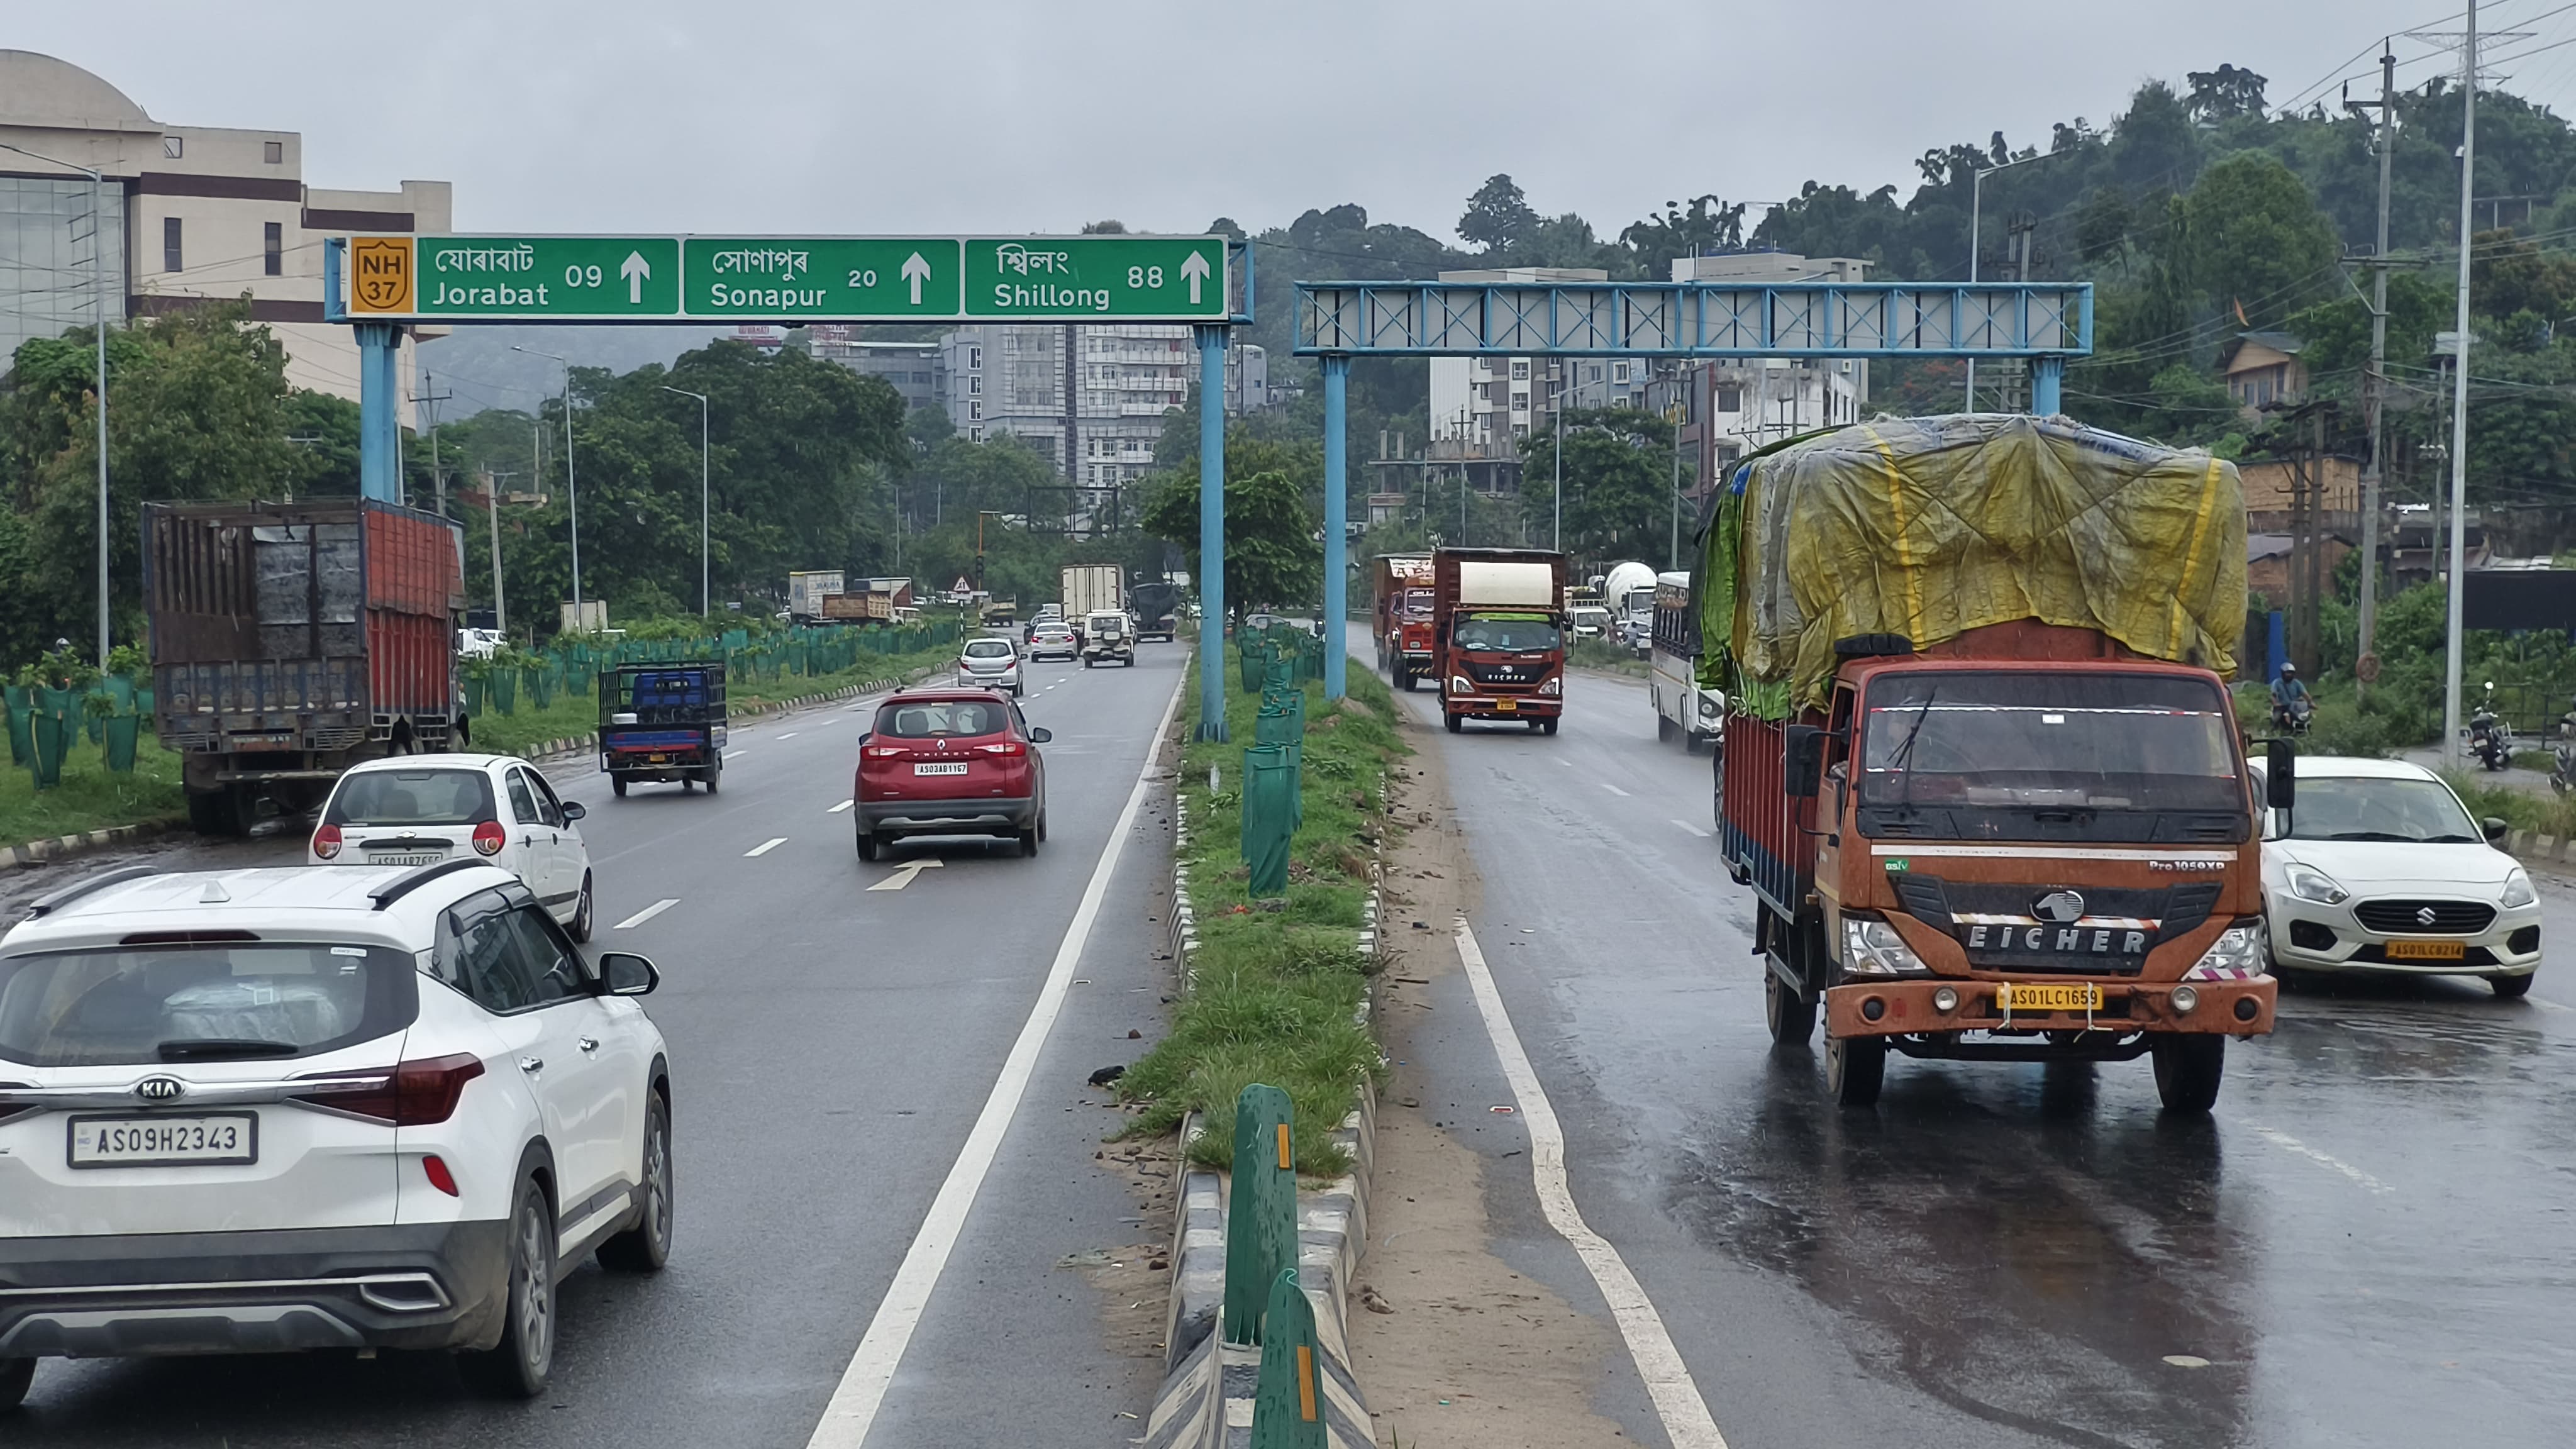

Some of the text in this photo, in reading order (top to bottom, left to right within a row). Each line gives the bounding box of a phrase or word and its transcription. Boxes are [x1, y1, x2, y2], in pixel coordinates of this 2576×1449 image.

[362, 255, 401, 275] NH
[435, 242, 534, 272] যোৰাবাট
[713, 248, 809, 281] সোণাপুৰ
[565, 265, 602, 287] 09
[848, 270, 877, 287] 20
[1128, 266, 1163, 289] 88
[367, 282, 397, 301] 37
[432, 282, 549, 306] Jorabat
[711, 283, 826, 311] Sonapur
[995, 283, 1109, 311] Shillong
[1968, 926, 2145, 953] EICHER
[2010, 989, 2098, 1006] AS01LC1659
[142, 1082, 177, 1096] KIA
[97, 1126, 236, 1153] AS09H2343
